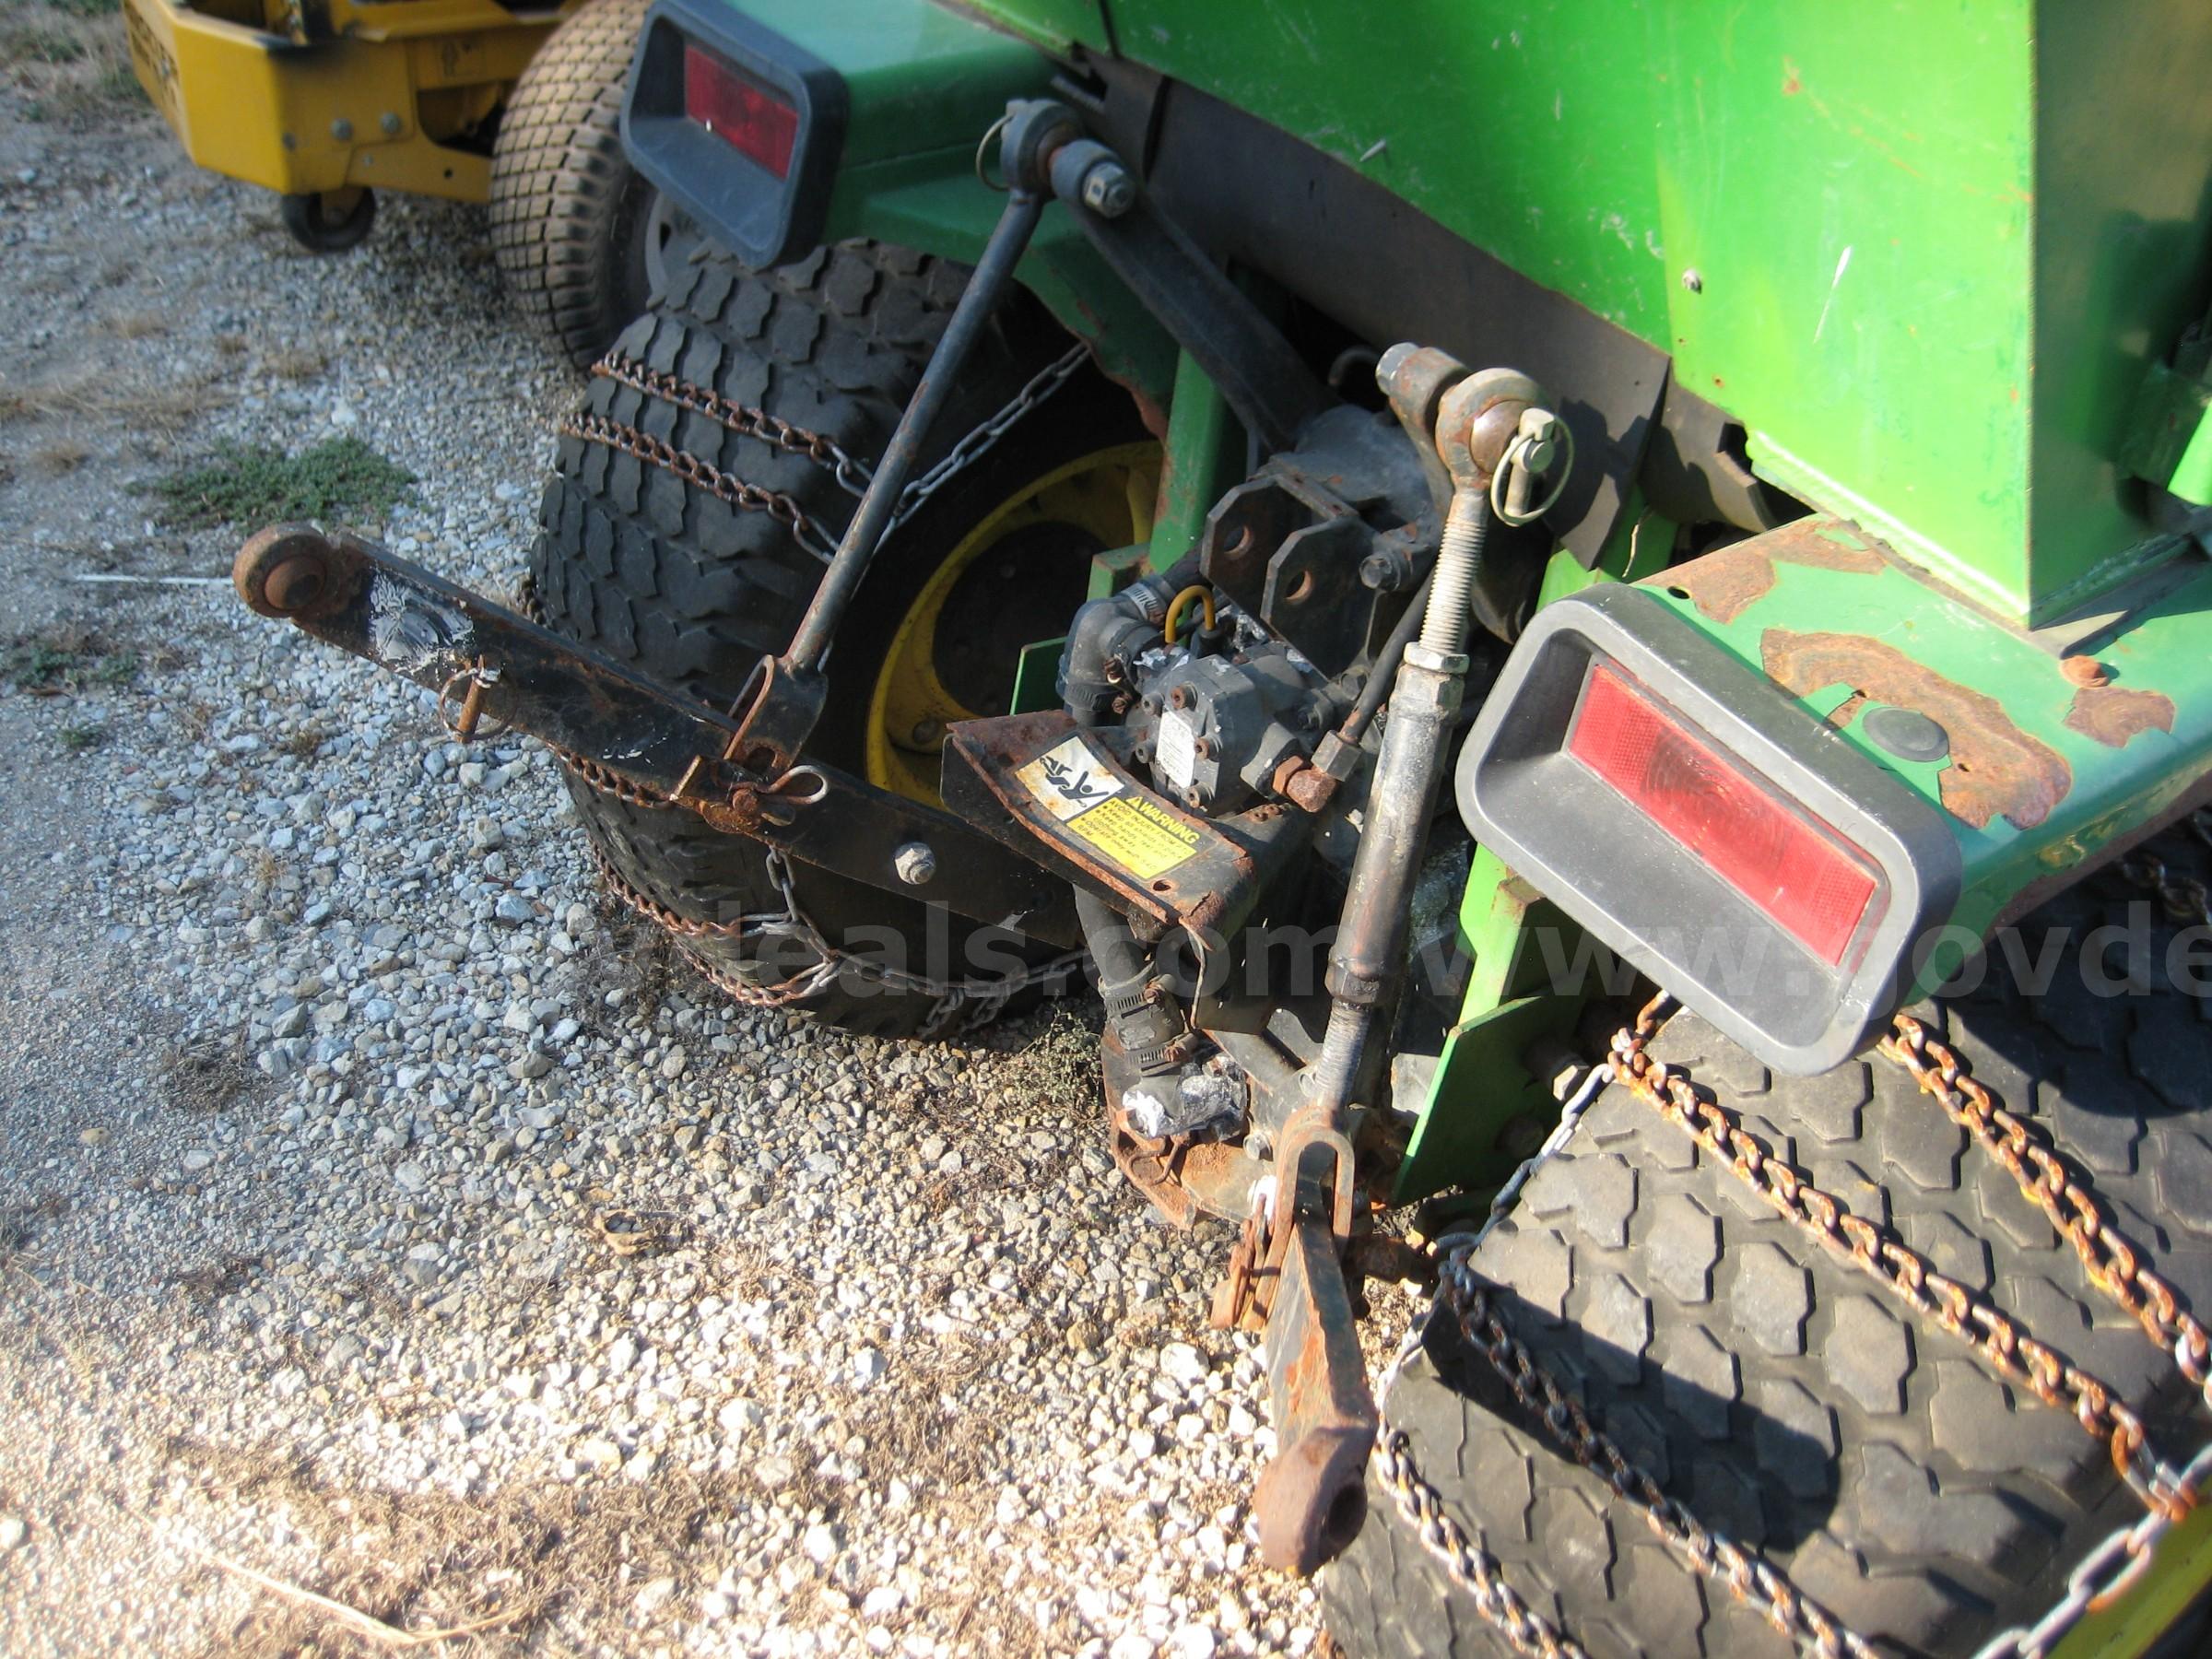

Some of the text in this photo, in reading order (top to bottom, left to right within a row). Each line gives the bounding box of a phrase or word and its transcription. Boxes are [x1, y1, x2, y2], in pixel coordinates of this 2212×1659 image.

[1107, 800, 1133, 816] AVOID
[1129, 815, 1157, 831] INJURY
[1154, 830, 1177, 845] FROM
[1139, 802, 1200, 843] WARNING
